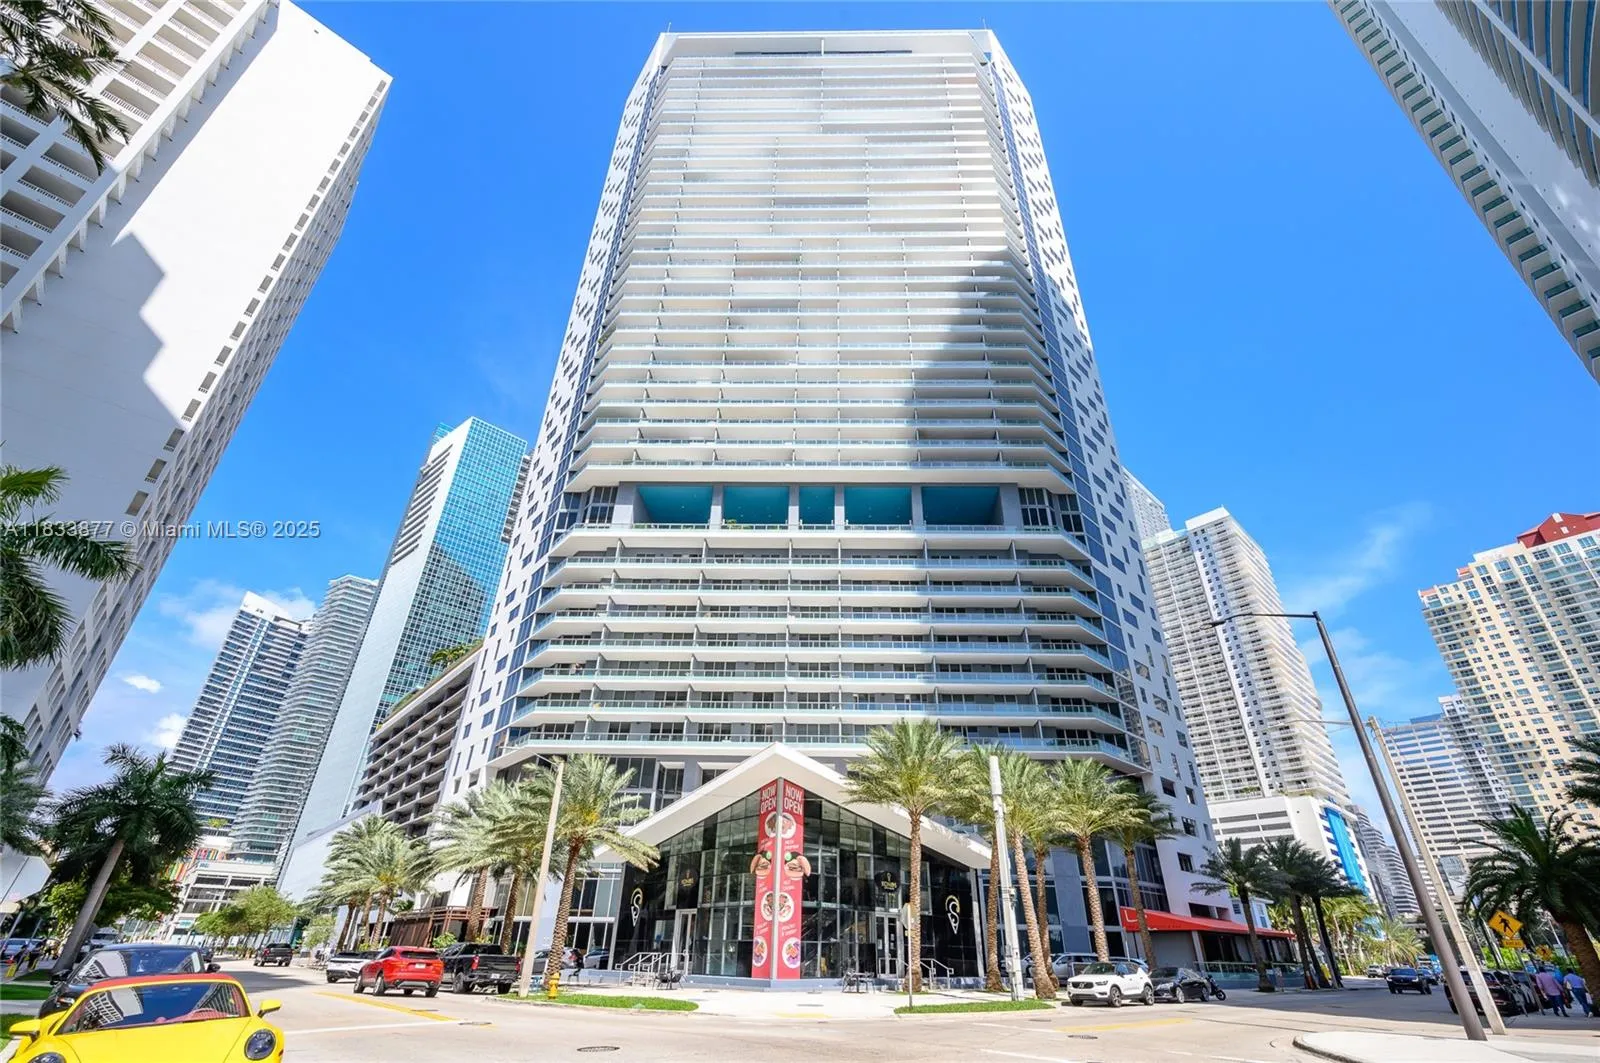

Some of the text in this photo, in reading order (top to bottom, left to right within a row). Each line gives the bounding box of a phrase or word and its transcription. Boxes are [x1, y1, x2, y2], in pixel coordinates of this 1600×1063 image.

[761, 783, 777, 801] NOW
[785, 784, 803, 803] NOW
[760, 797, 777, 814] OPEN
[783, 797, 803, 816] OPEN
